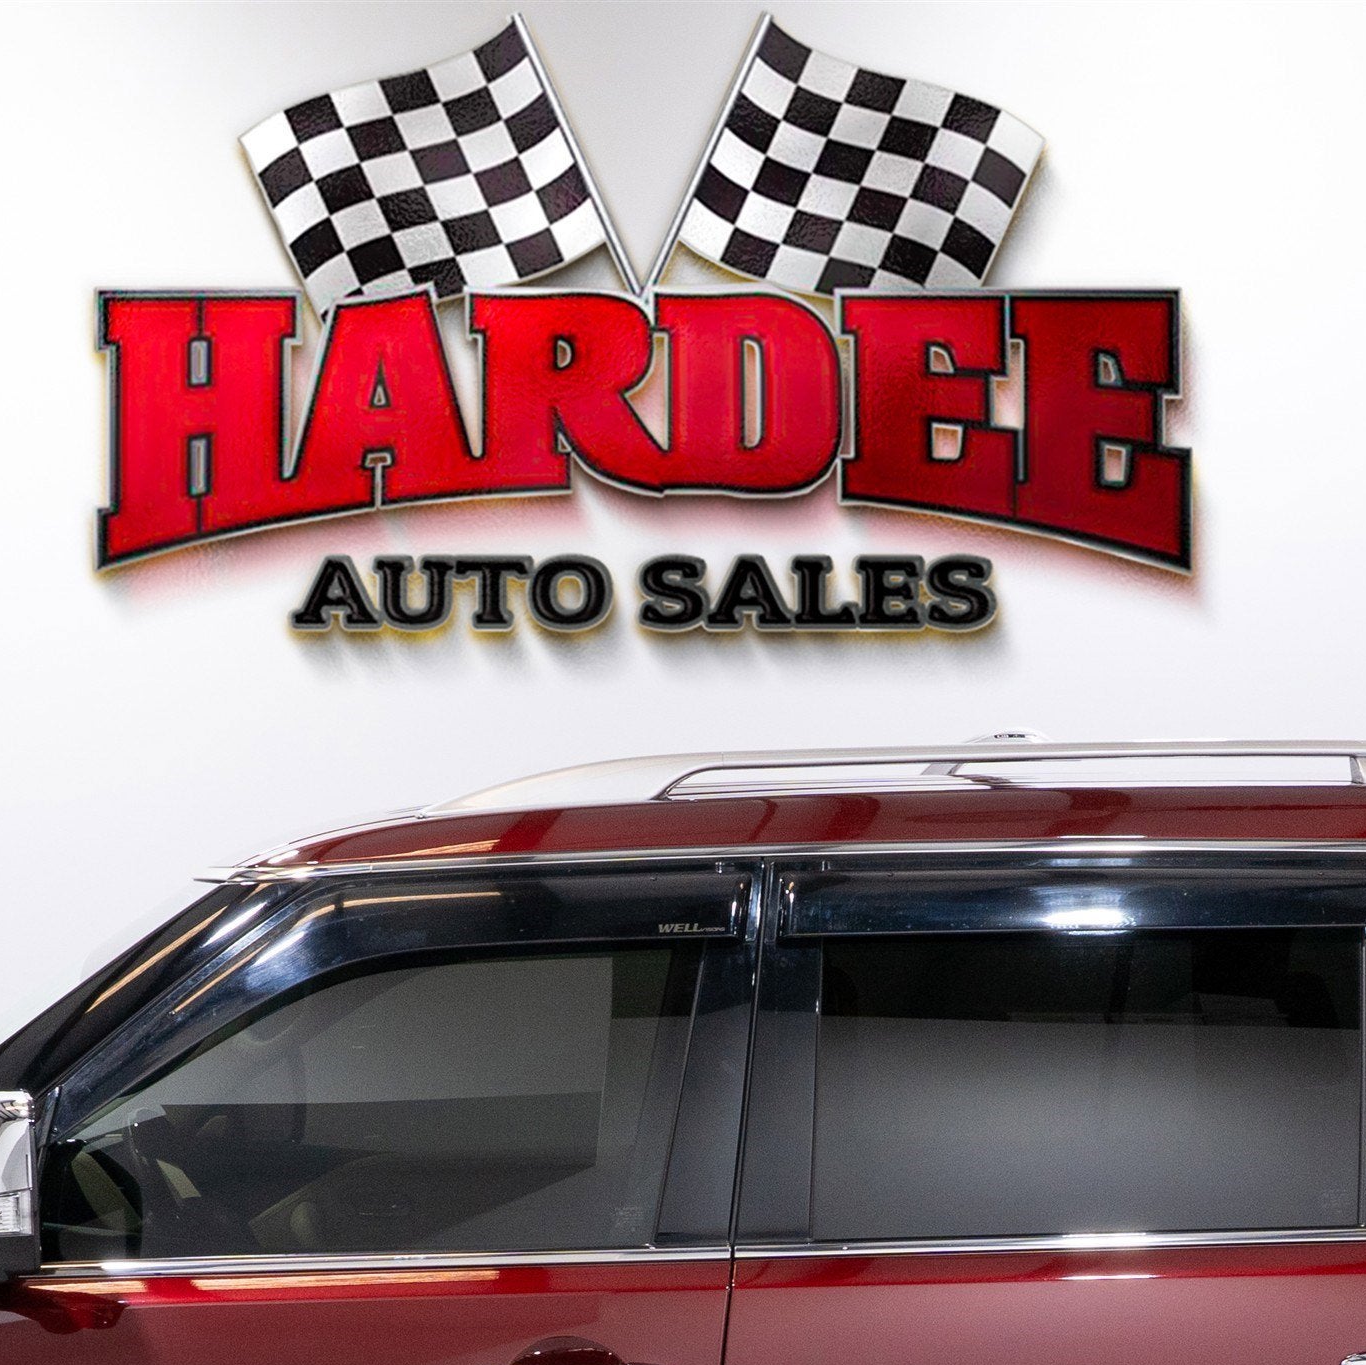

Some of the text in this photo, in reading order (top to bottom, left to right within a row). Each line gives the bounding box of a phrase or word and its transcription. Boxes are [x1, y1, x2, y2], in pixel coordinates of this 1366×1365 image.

[97, 284, 1192, 576] HARDEE
[291, 553, 998, 632] AUTO SALES
